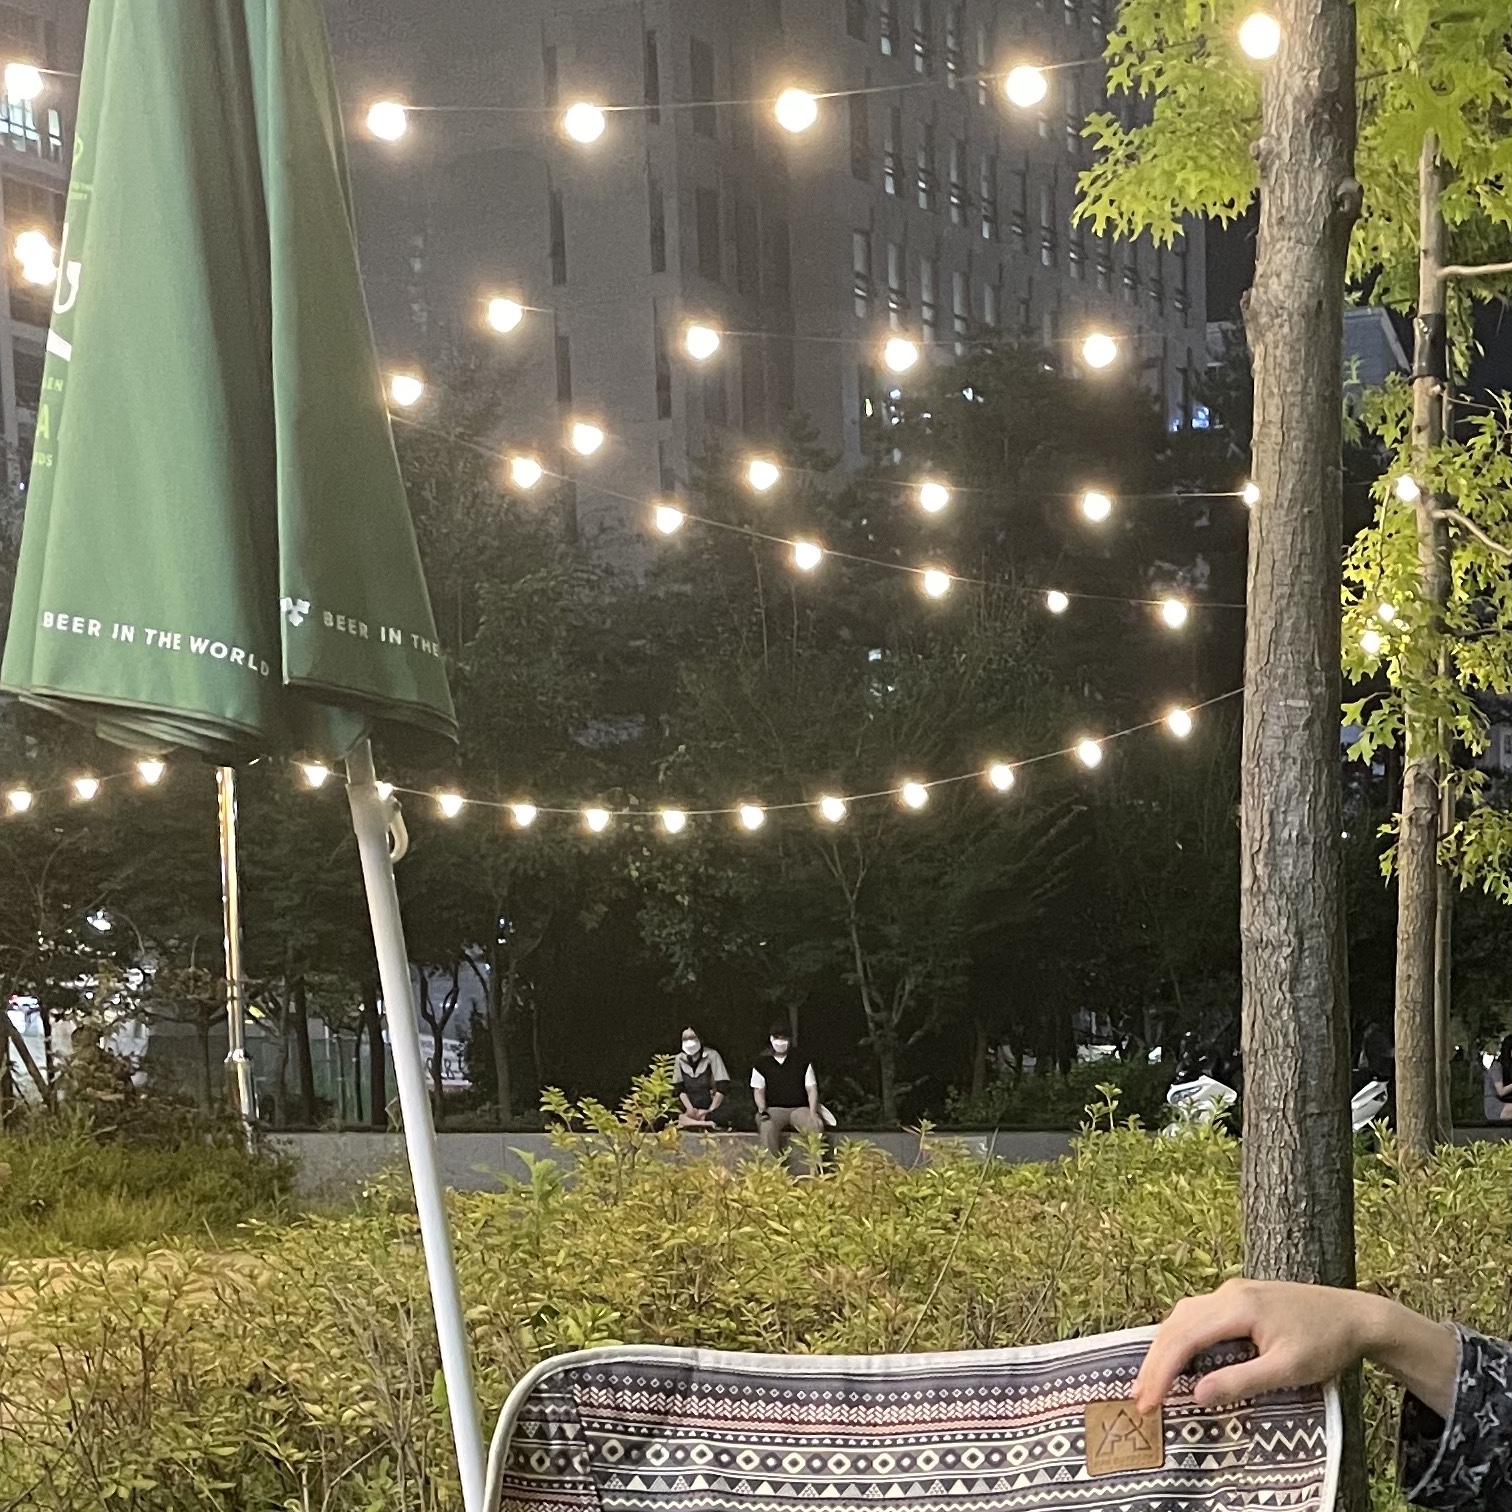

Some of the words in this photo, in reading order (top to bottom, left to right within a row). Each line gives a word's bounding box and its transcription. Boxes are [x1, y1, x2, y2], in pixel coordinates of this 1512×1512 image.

[42, 611, 101, 637] BEER
[111, 622, 135, 643] IN
[144, 628, 182, 651] THE
[189, 635, 270, 677] WORLD
[323, 610, 369, 640] BEER
[380, 626, 402, 645] IN
[411, 633, 440, 658] THE
